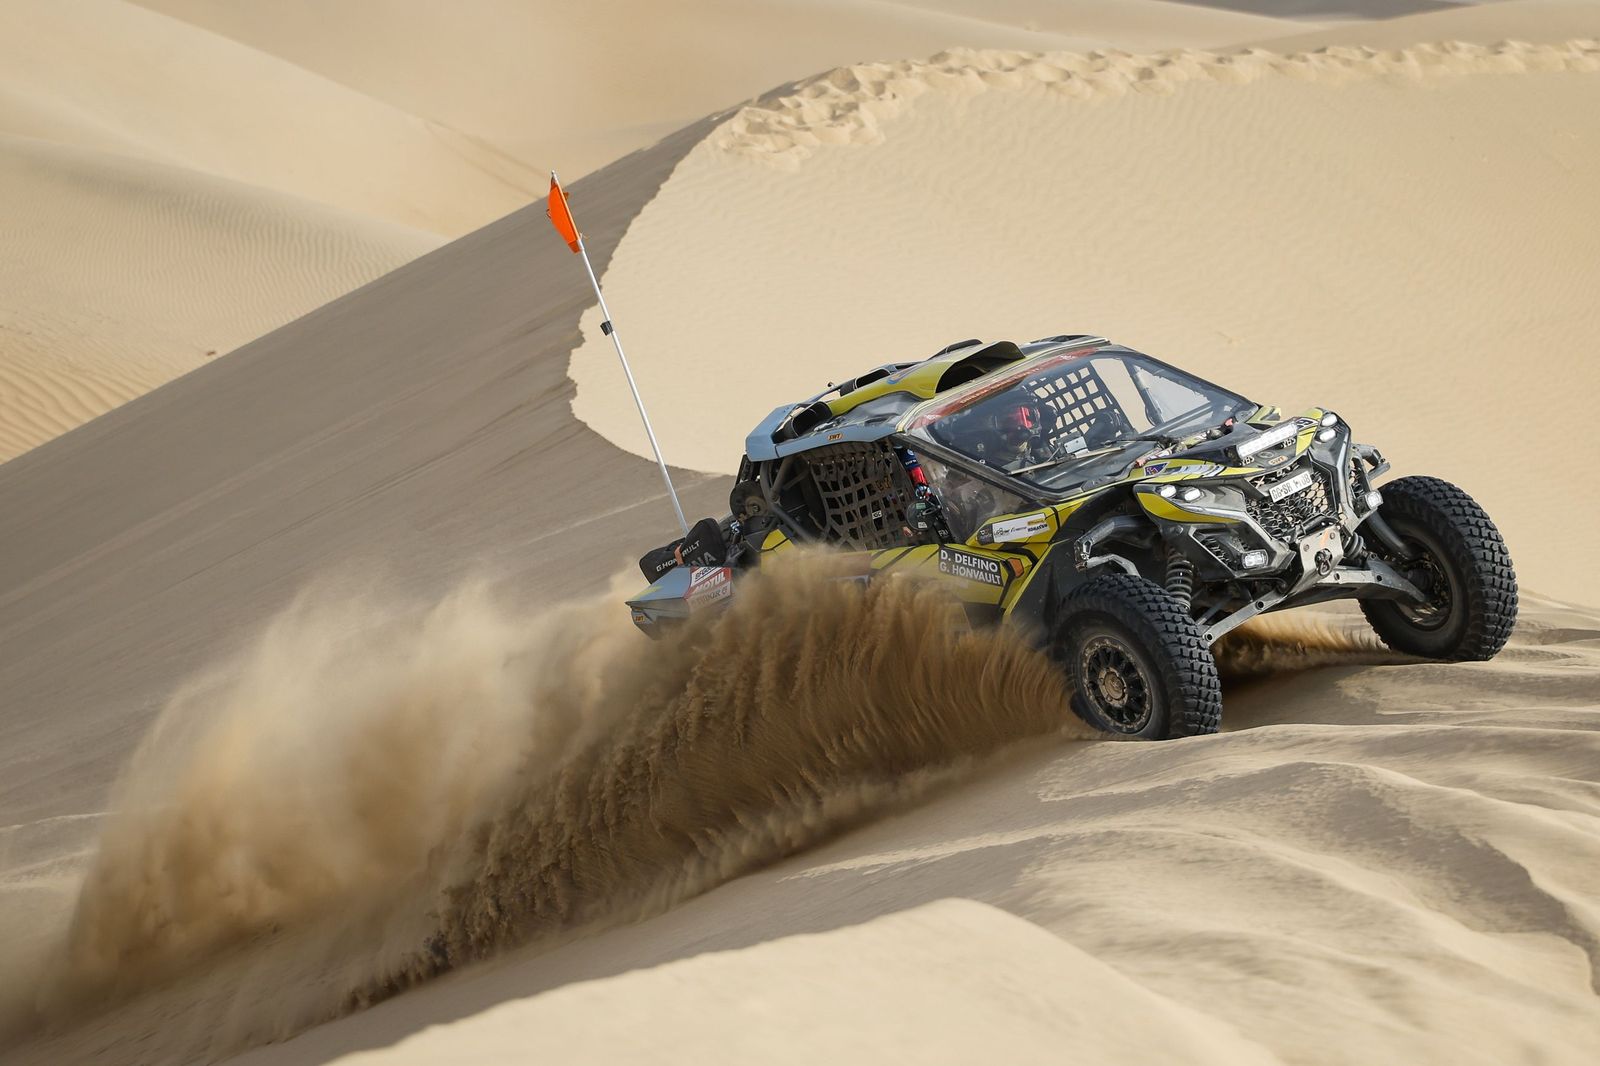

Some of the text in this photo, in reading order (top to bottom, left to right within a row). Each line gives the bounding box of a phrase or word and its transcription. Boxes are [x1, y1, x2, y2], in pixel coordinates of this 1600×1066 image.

[940, 549, 998, 572] D. DELFINO
[940, 562, 1000, 585] G. HONVAULT
